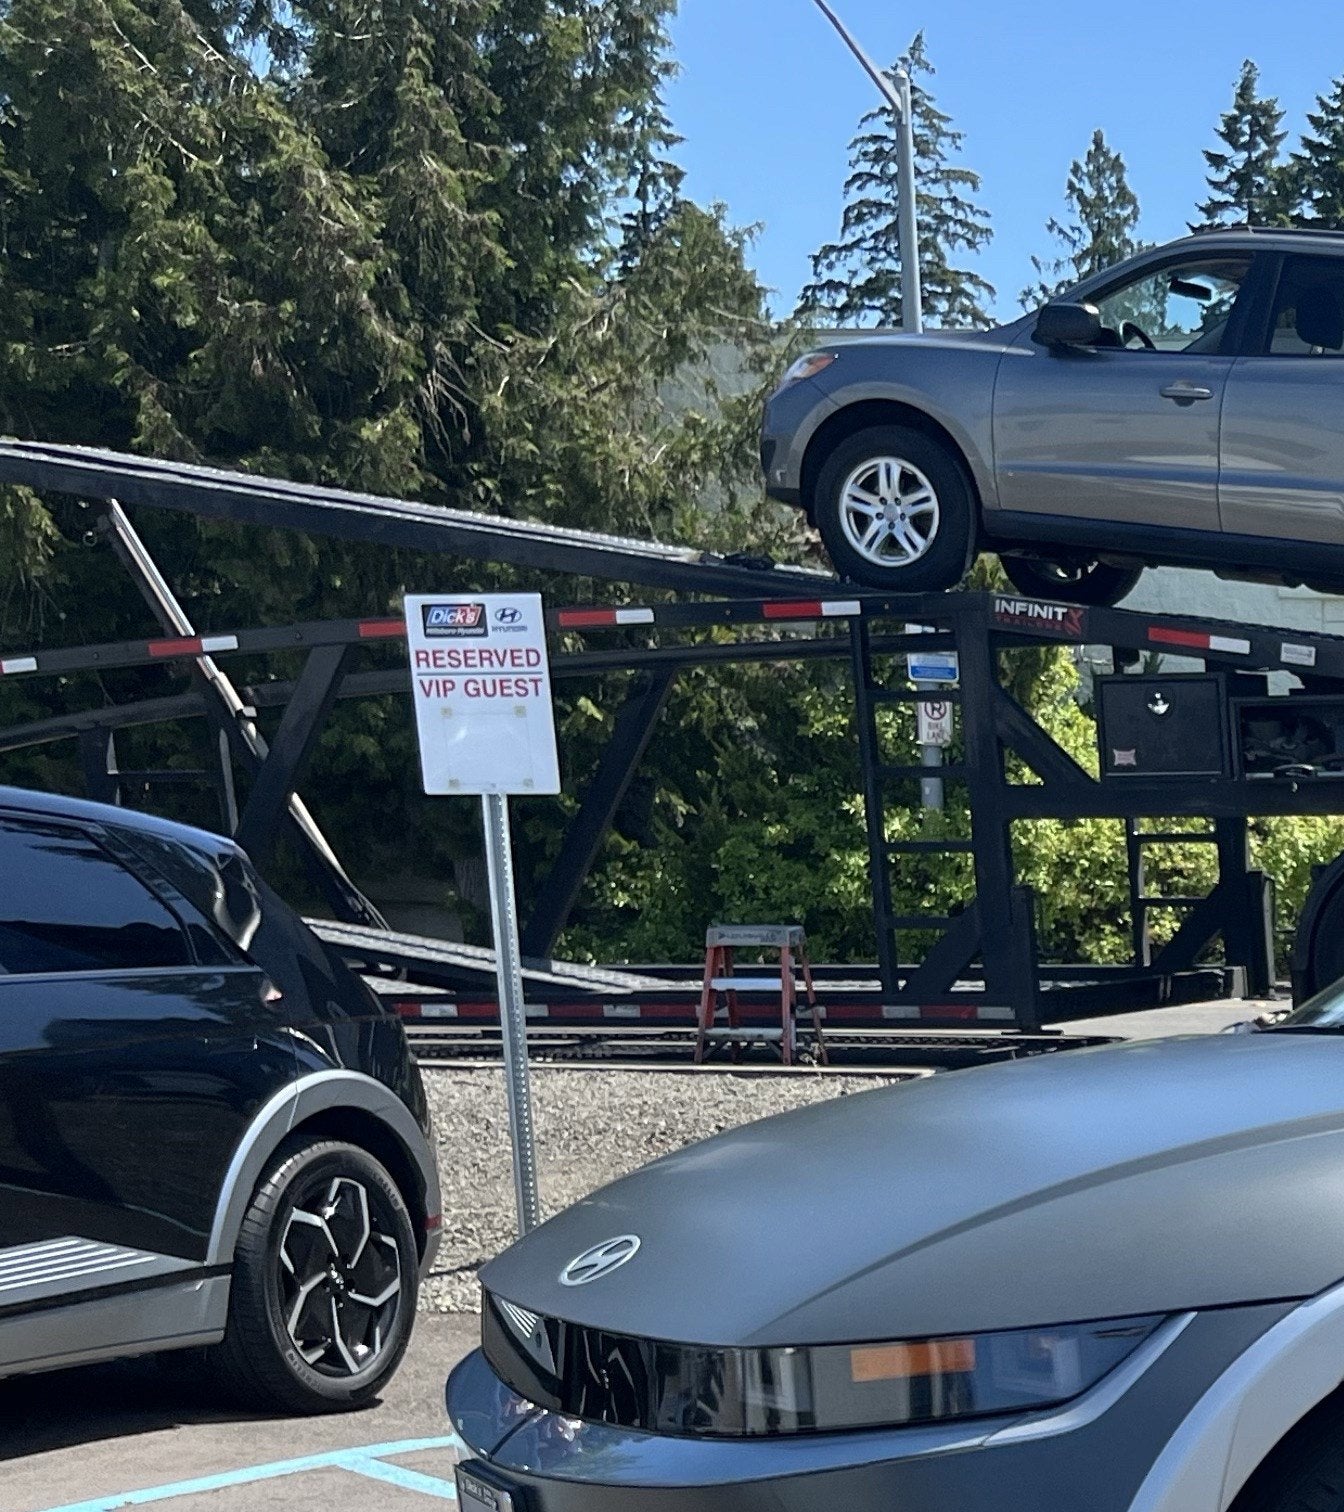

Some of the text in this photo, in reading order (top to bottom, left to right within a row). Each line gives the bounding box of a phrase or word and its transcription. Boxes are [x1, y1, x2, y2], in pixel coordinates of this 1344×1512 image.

[415, 648, 541, 668] RESERVED
[419, 678, 543, 698] VIP GUEST
